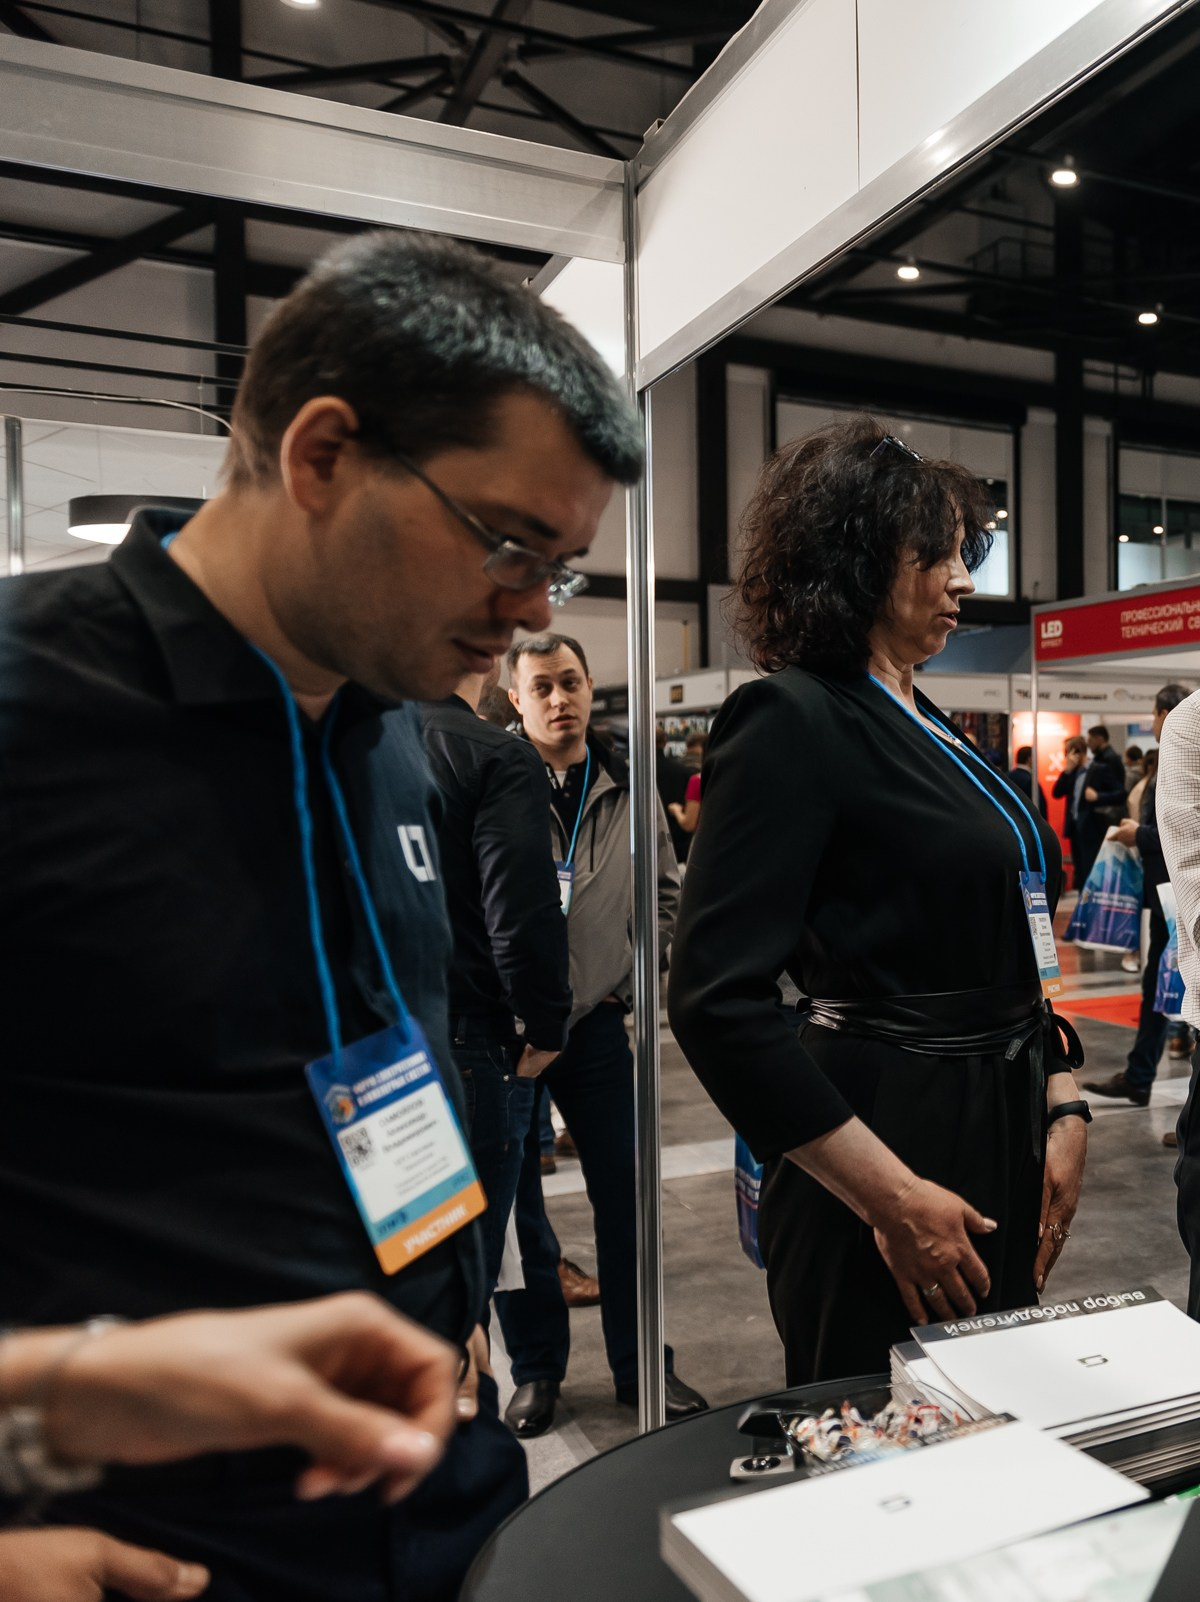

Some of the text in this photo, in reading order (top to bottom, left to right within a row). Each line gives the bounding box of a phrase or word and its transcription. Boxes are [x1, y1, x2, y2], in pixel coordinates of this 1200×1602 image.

[1041, 620, 1063, 638] LED
[1120, 616, 1183, 639] ТЕХНИЧЕСКИЙ
[403, 1203, 469, 1255] УЧАСТНИК
[944, 1290, 1146, 1337] выбор победителей
